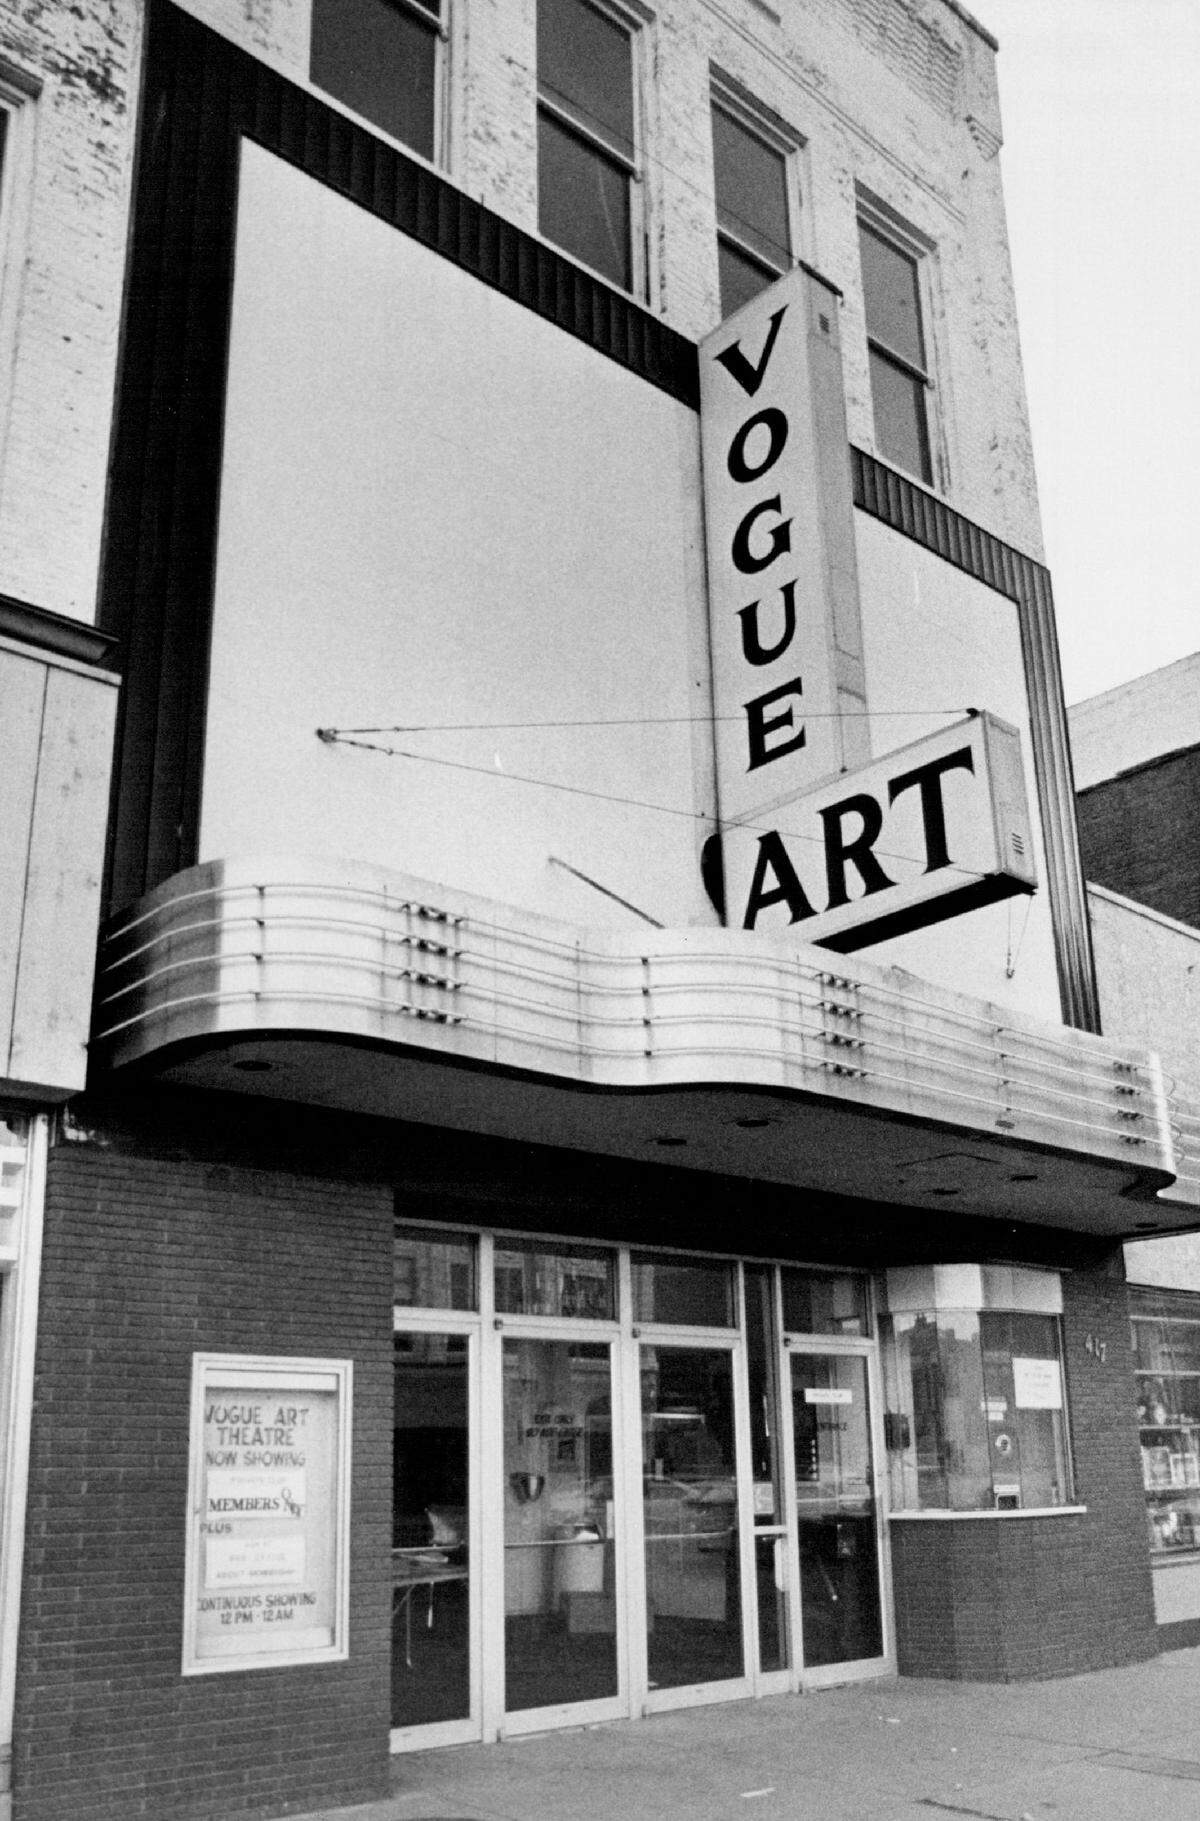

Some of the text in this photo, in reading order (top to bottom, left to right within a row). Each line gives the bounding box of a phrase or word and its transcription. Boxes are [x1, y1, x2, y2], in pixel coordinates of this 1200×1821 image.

[714, 304, 807, 773] VOGUE
[743, 745, 976, 930] ART
[204, 1405, 309, 1426] VOGUE ART
[217, 1427, 294, 1447] THEATRE
[206, 1451, 306, 1468] NOW SHOWING
[208, 1498, 280, 1512] MEMBERS
[200, 1522, 232, 1534] PLUS
[265, 1592, 317, 1608] SHOWING
[221, 1612, 232, 1625] 12
[234, 1611, 252, 1625] PM
[263, 1609, 274, 1622] 12
[275, 1608, 293, 1621] AM
